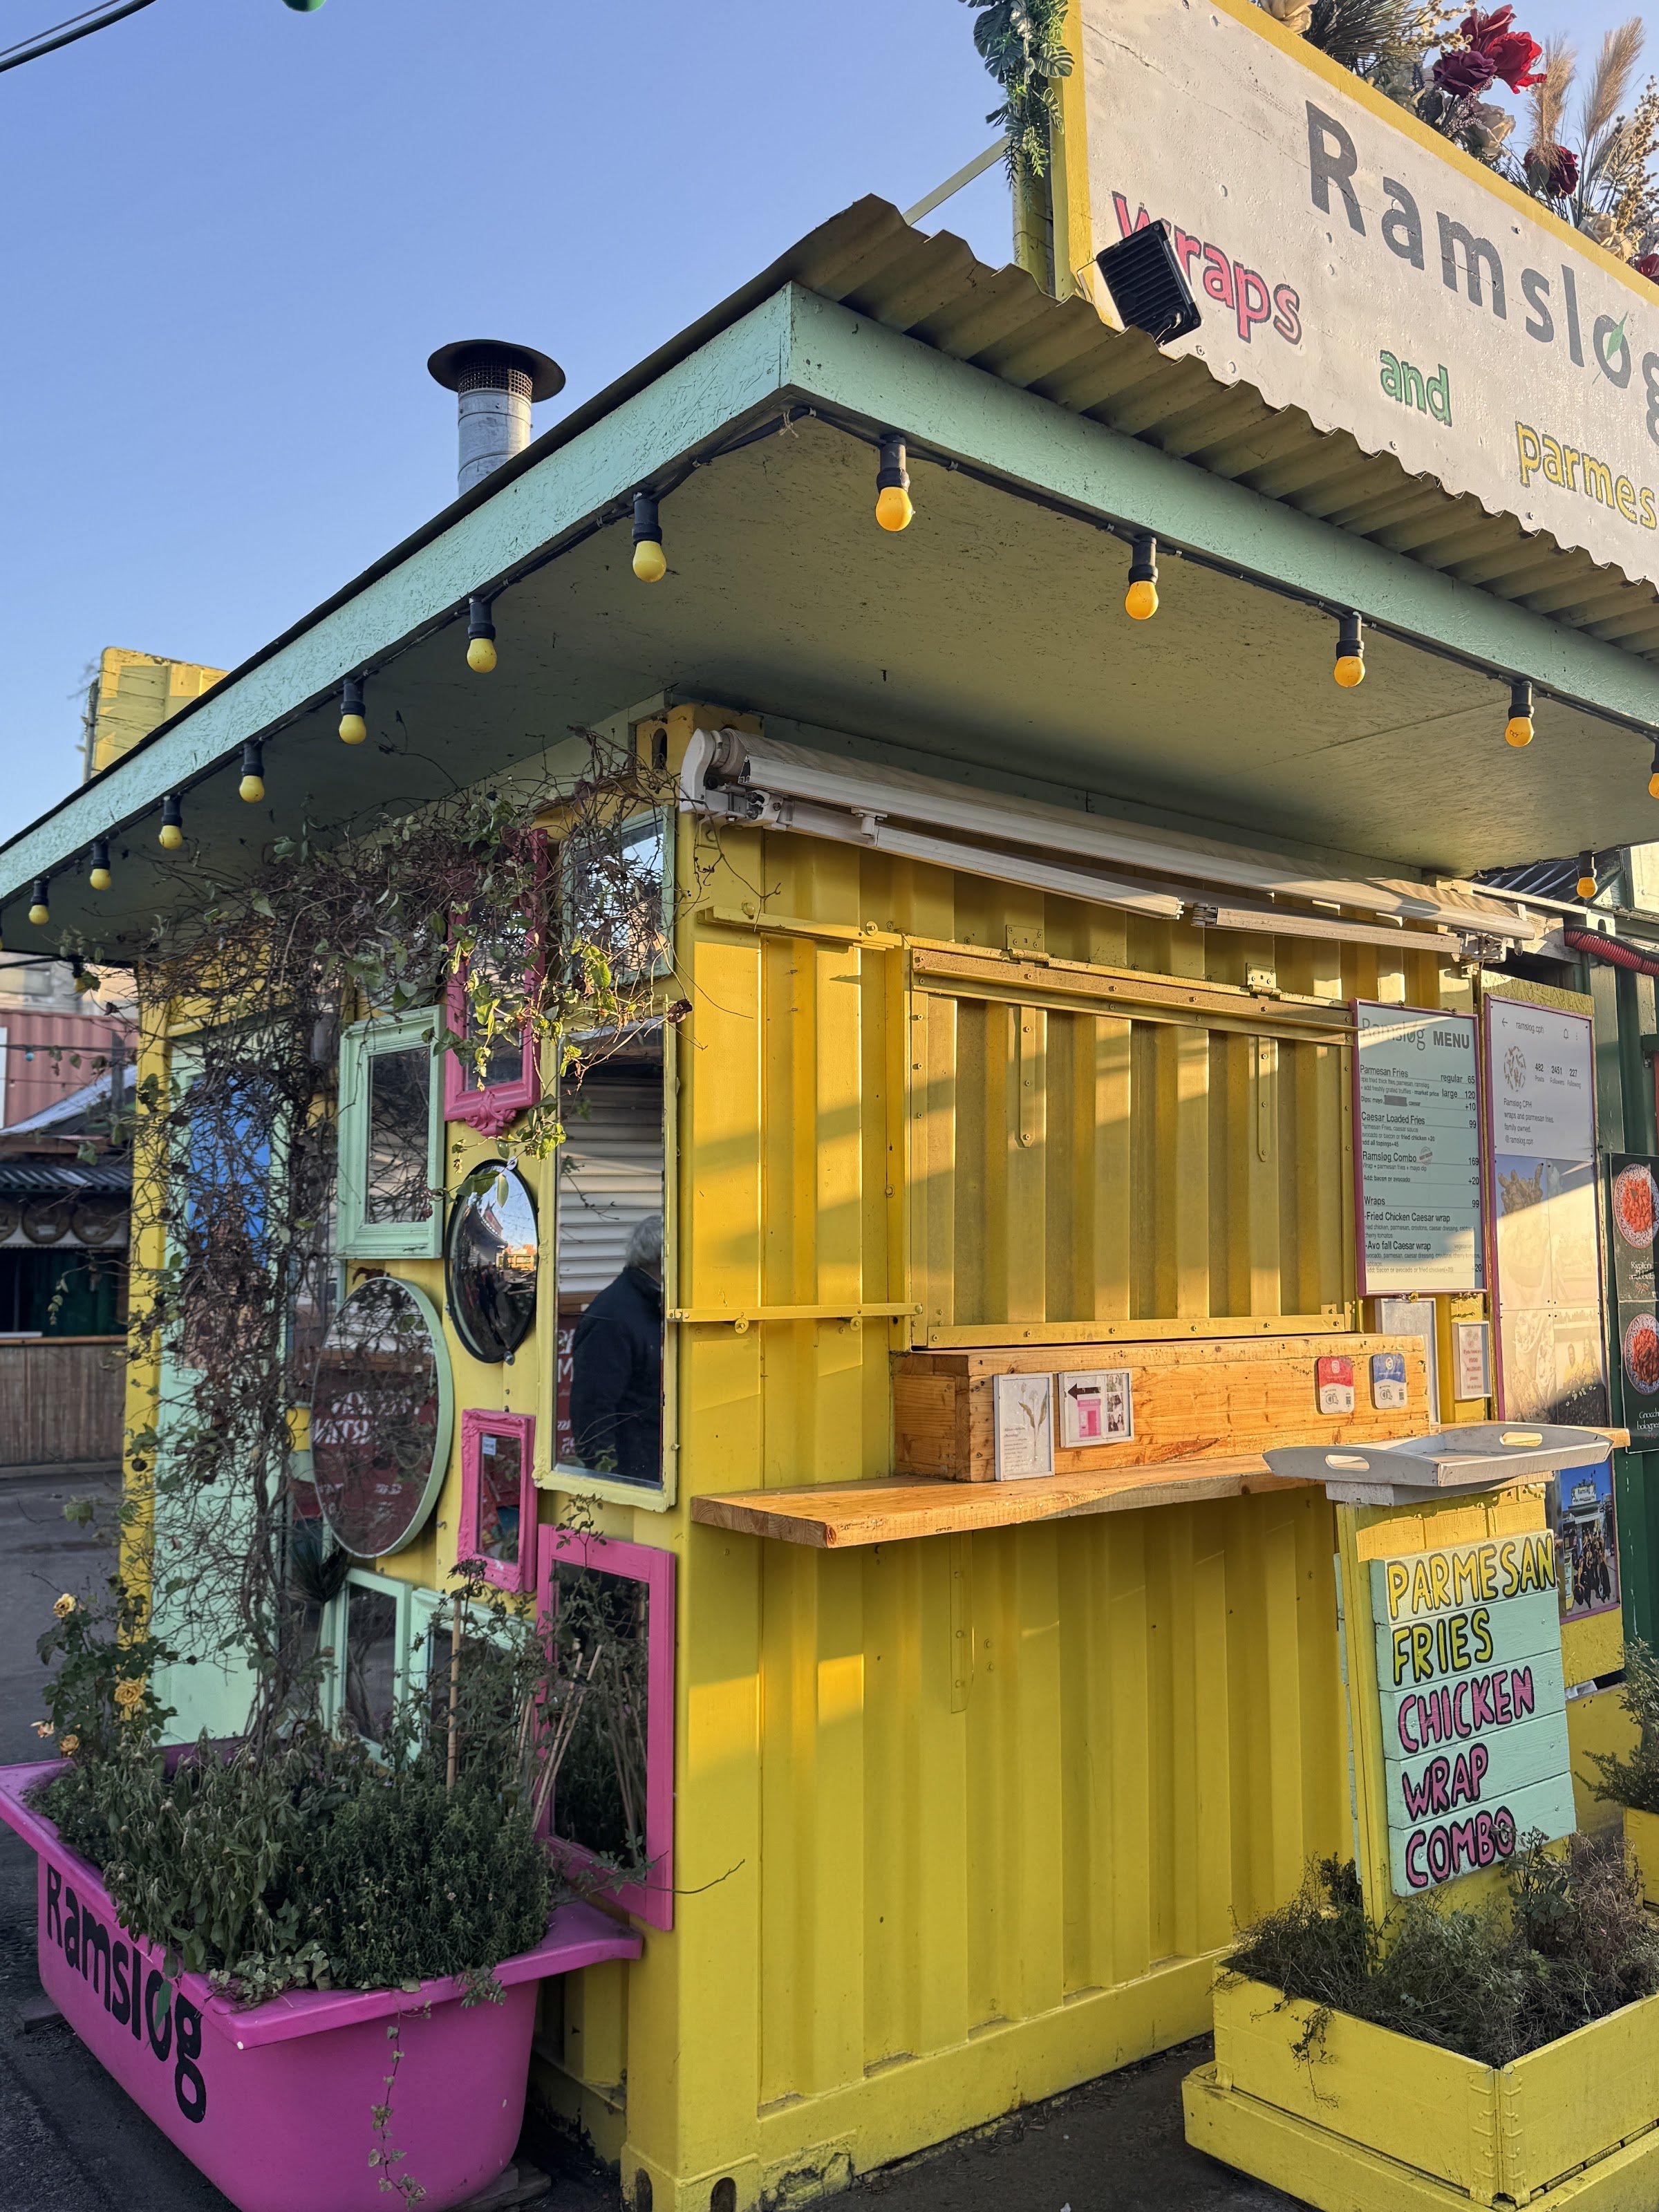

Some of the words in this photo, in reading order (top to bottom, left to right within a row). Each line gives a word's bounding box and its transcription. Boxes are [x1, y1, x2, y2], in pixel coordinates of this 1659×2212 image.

[1380, 350, 1452, 427] and
[1515, 420, 1657, 531] parmes
[1433, 1031, 1470, 1049] MENU
[1360, 1065, 1391, 1076] Parmesan
[1392, 1068, 1409, 1078] Fries
[1441, 1074, 1463, 1084] regular
[1468, 1076, 1475, 1084] 65
[1442, 1089, 1458, 1099] large
[1465, 1091, 1475, 1100] 120
[1465, 1103, 1477, 1111] +10
[1361, 1112, 1385, 1121] Caesar
[1387, 1114, 1409, 1123] Loaded
[1410, 1116, 1425, 1125] Fries
[1469, 1120, 1477, 1128] 99
[1362, 1151, 1391, 1163] Ramsløg
[1393, 1152, 1417, 1163] Combo
[1469, 1157, 1479, 1165] 169
[1364, 1196, 1385, 1207] Wraps
[1472, 1199, 1479, 1208] 99
[1385, 1212, 1410, 1221] Chicken
[1412, 1212, 1434, 1221] Caesar
[1435, 1215, 1450, 1224] wrap
[1382, 1241, 1391, 1250] fall
[1393, 1240, 1415, 1250] Caesar
[1416, 1243, 1431, 1252] wrap
[1387, 1533, 1557, 1621] PARMESAN
[1393, 1608, 1493, 1686] FRIES
[1398, 1665, 1535, 1753] CHICKEN
[1402, 1743, 1488, 1821] WRAP
[1405, 1806, 1516, 1888] COMBO
